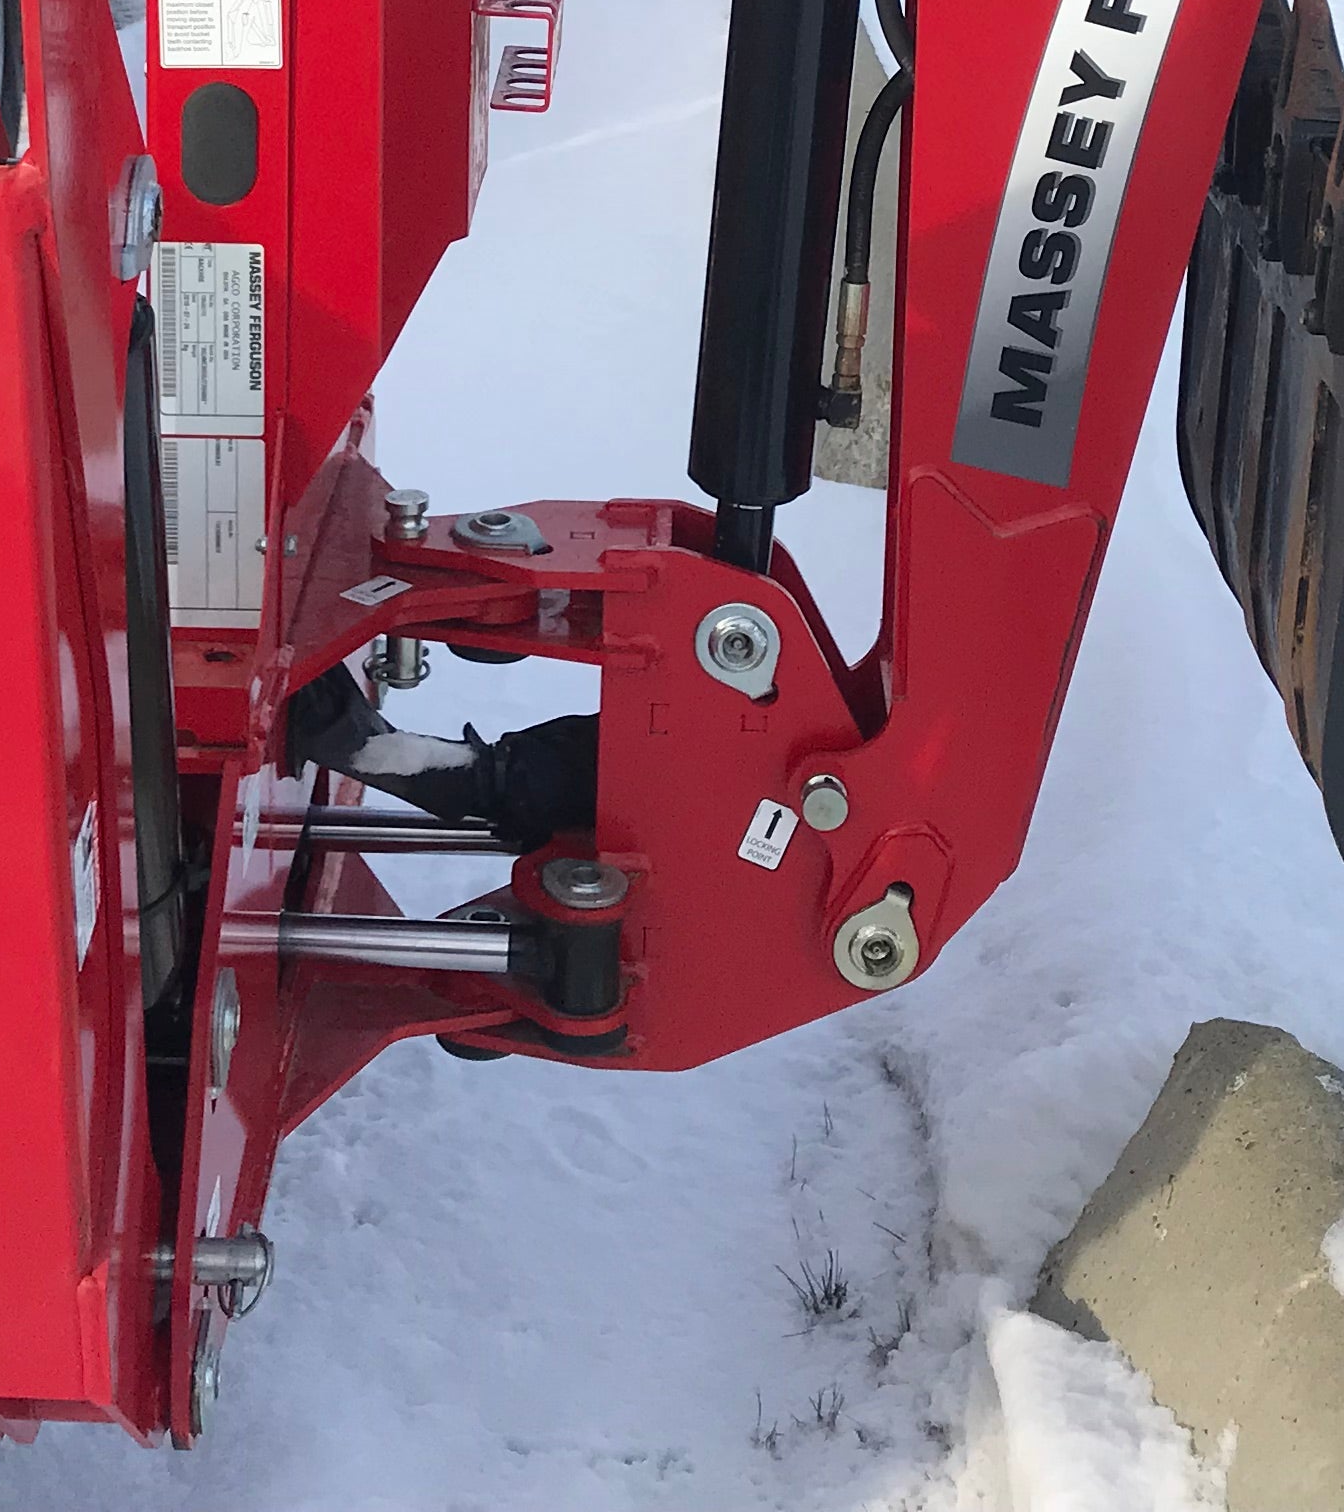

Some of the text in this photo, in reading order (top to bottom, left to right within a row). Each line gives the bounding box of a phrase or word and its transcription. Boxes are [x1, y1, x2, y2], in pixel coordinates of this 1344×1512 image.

[990, 48, 1127, 428] MASSEY
[231, 270, 241, 371] AGCO CORPORATION
[249, 252, 262, 391] MASSEY FERGUSON
[746, 836, 781, 862] LOCKING POINT
